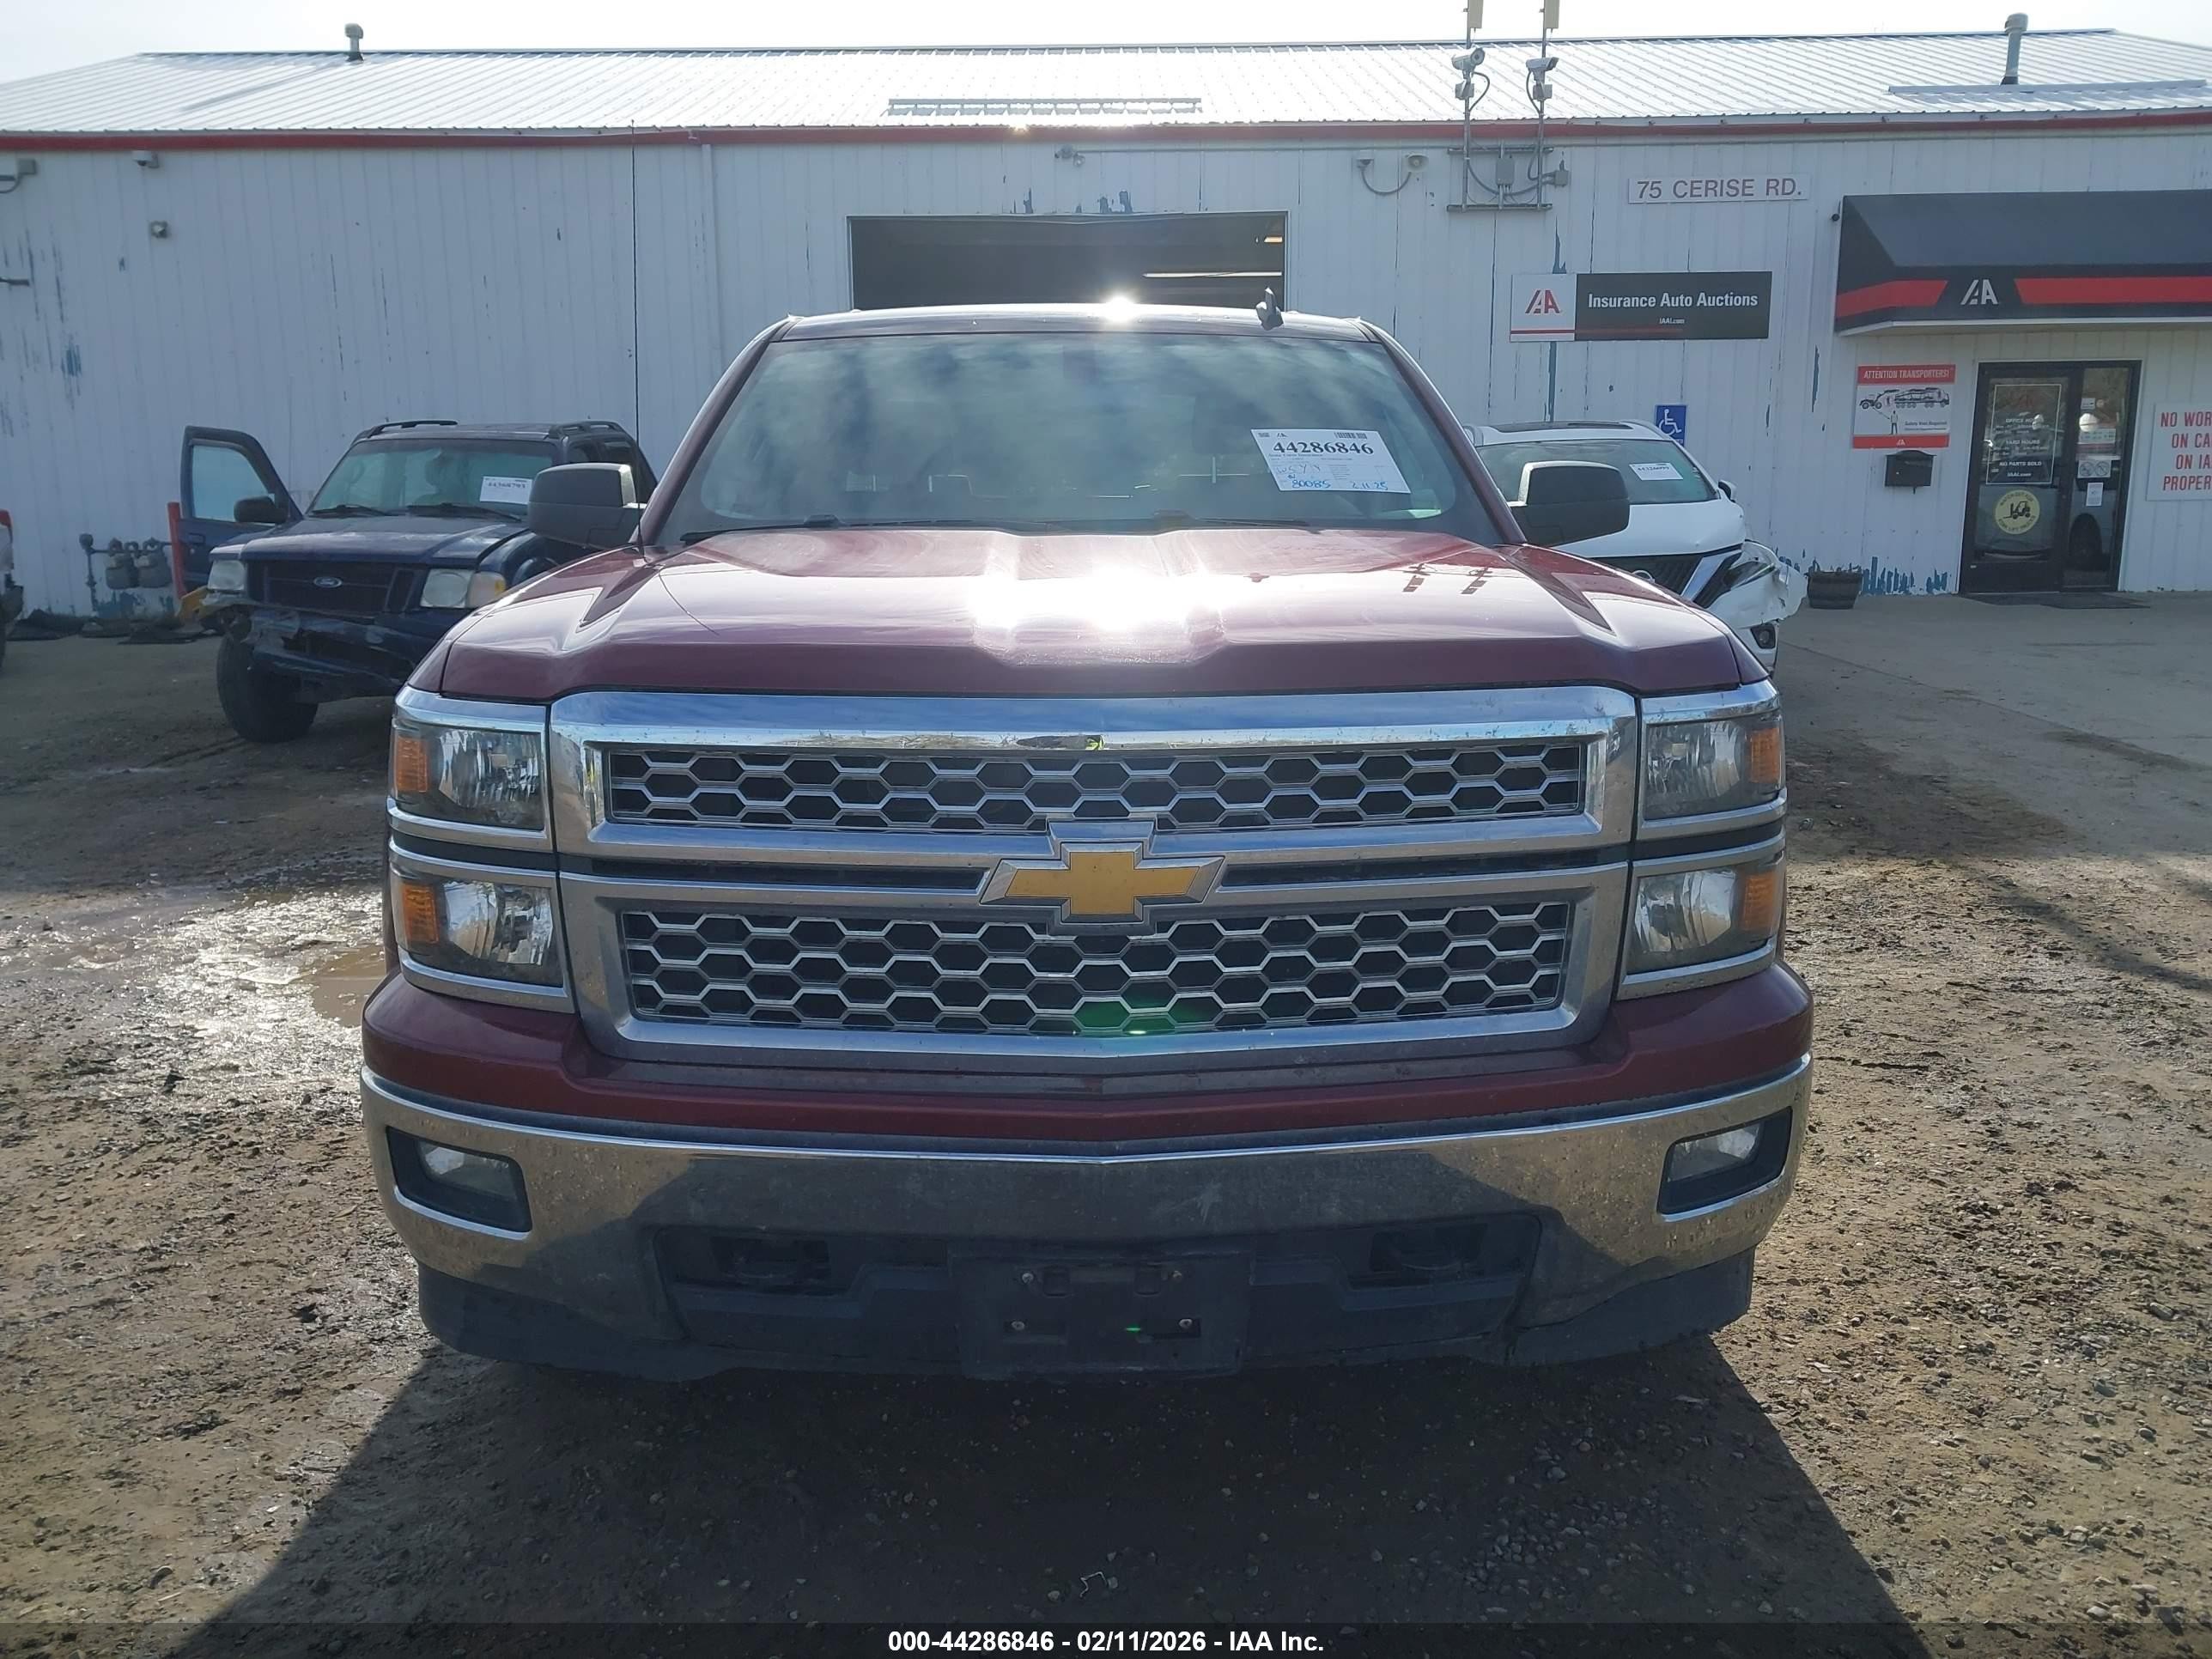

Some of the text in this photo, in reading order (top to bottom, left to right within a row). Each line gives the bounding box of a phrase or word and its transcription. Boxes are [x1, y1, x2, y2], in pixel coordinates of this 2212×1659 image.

[1637, 178, 1802, 199] 75 CERISE RD.
[1588, 291, 1759, 308] Insurance Auto Auctions
[1863, 369, 1949, 379] ATTENTION TRANSPORTERS!
[2160, 411, 2212, 427] NO WOR
[1273, 441, 1374, 455] 44286846
[2172, 432, 2212, 448] ON CA
[2176, 453, 2212, 470] ON IA
[2162, 476, 2212, 491] PROPER
